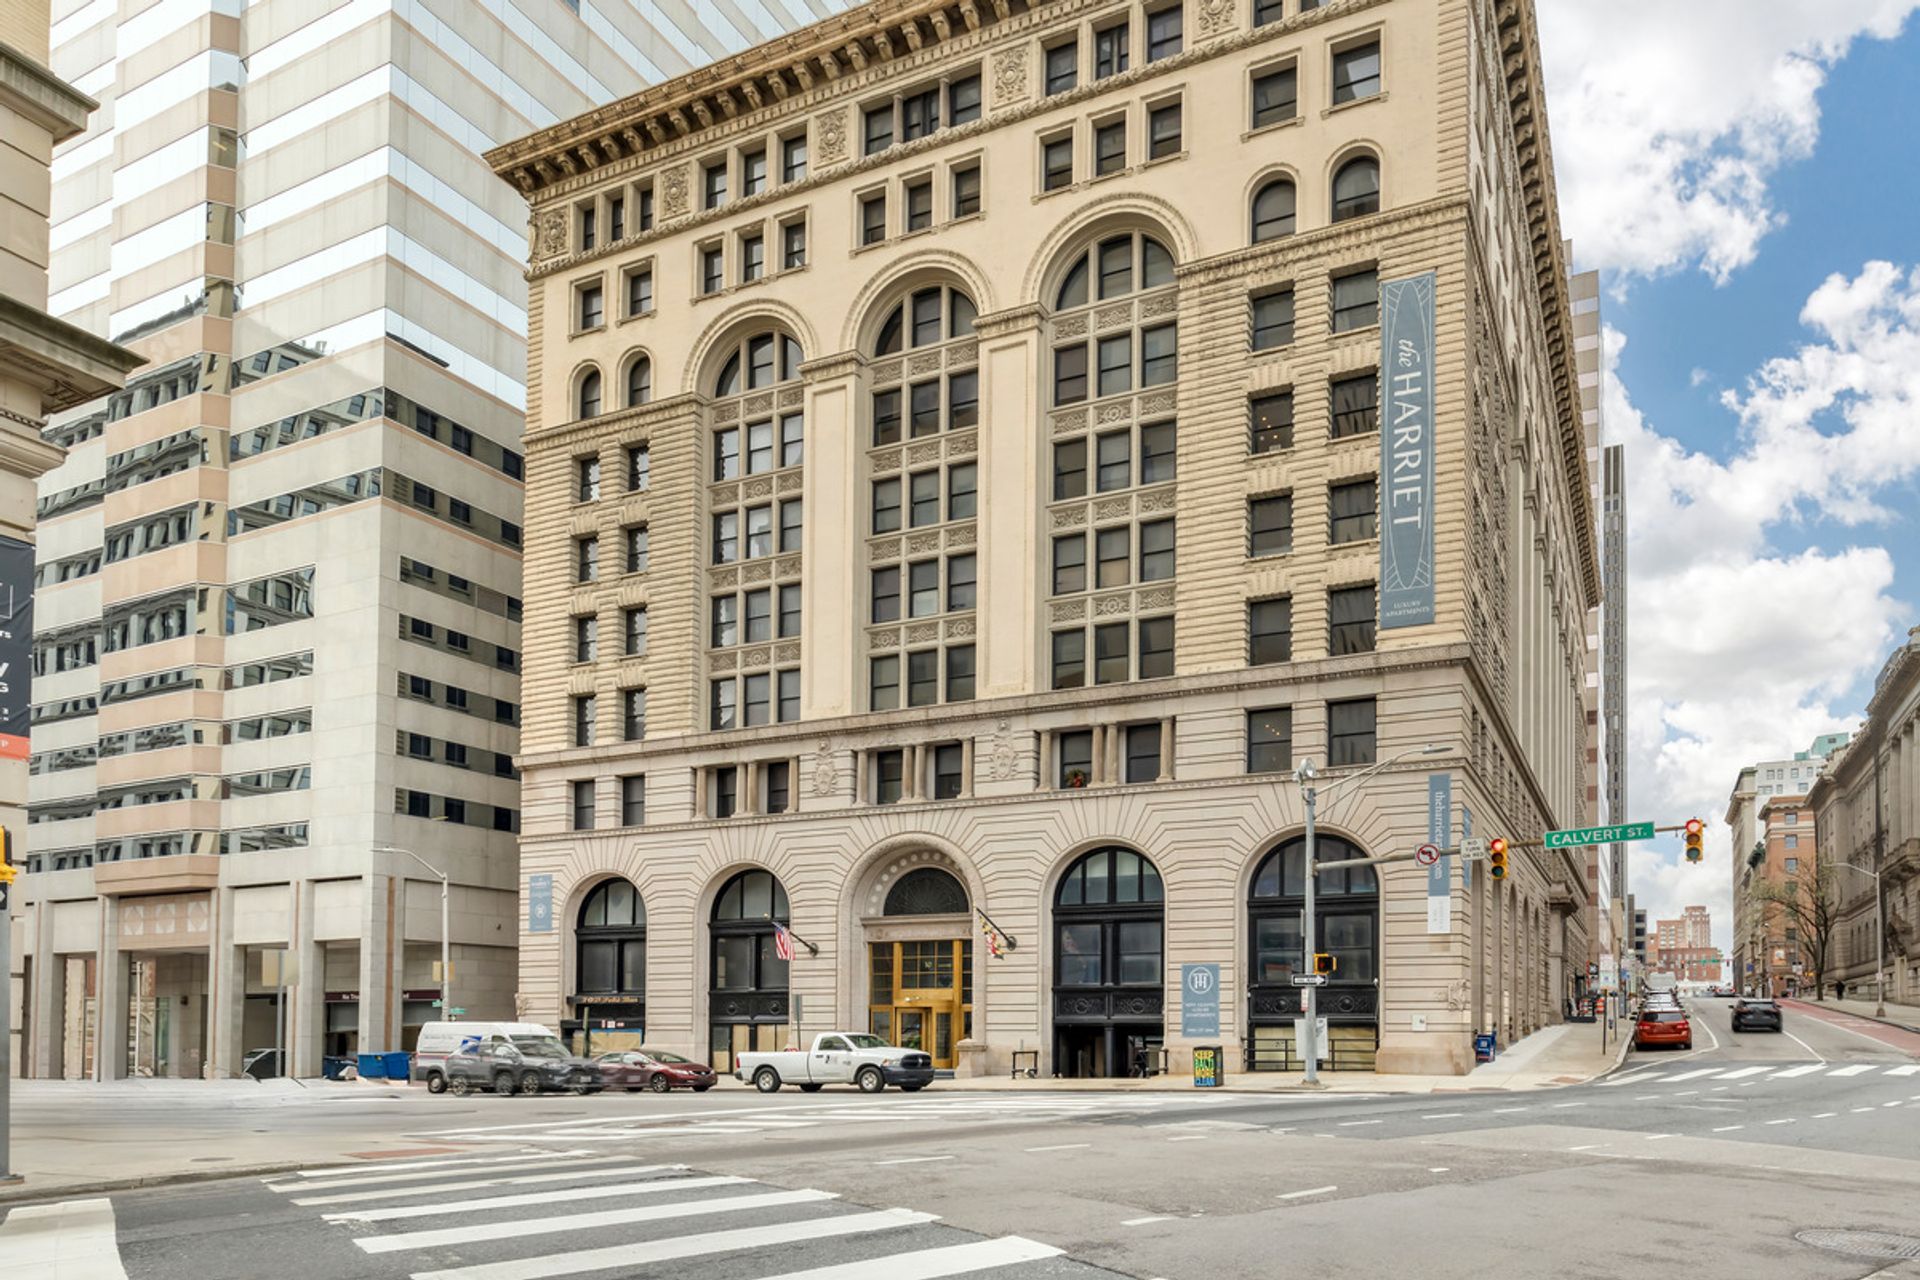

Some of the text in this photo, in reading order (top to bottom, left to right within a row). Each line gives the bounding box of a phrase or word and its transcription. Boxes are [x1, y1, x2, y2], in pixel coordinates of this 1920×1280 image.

[1393, 337, 1422, 529] the HARRIET
[1393, 600, 1421, 609] LUXURY
[1385, 606, 1430, 617] APARTMENTS
[1552, 827, 1647, 845] CALVERT ST.
[1193, 1050, 1214, 1059] KEEP
